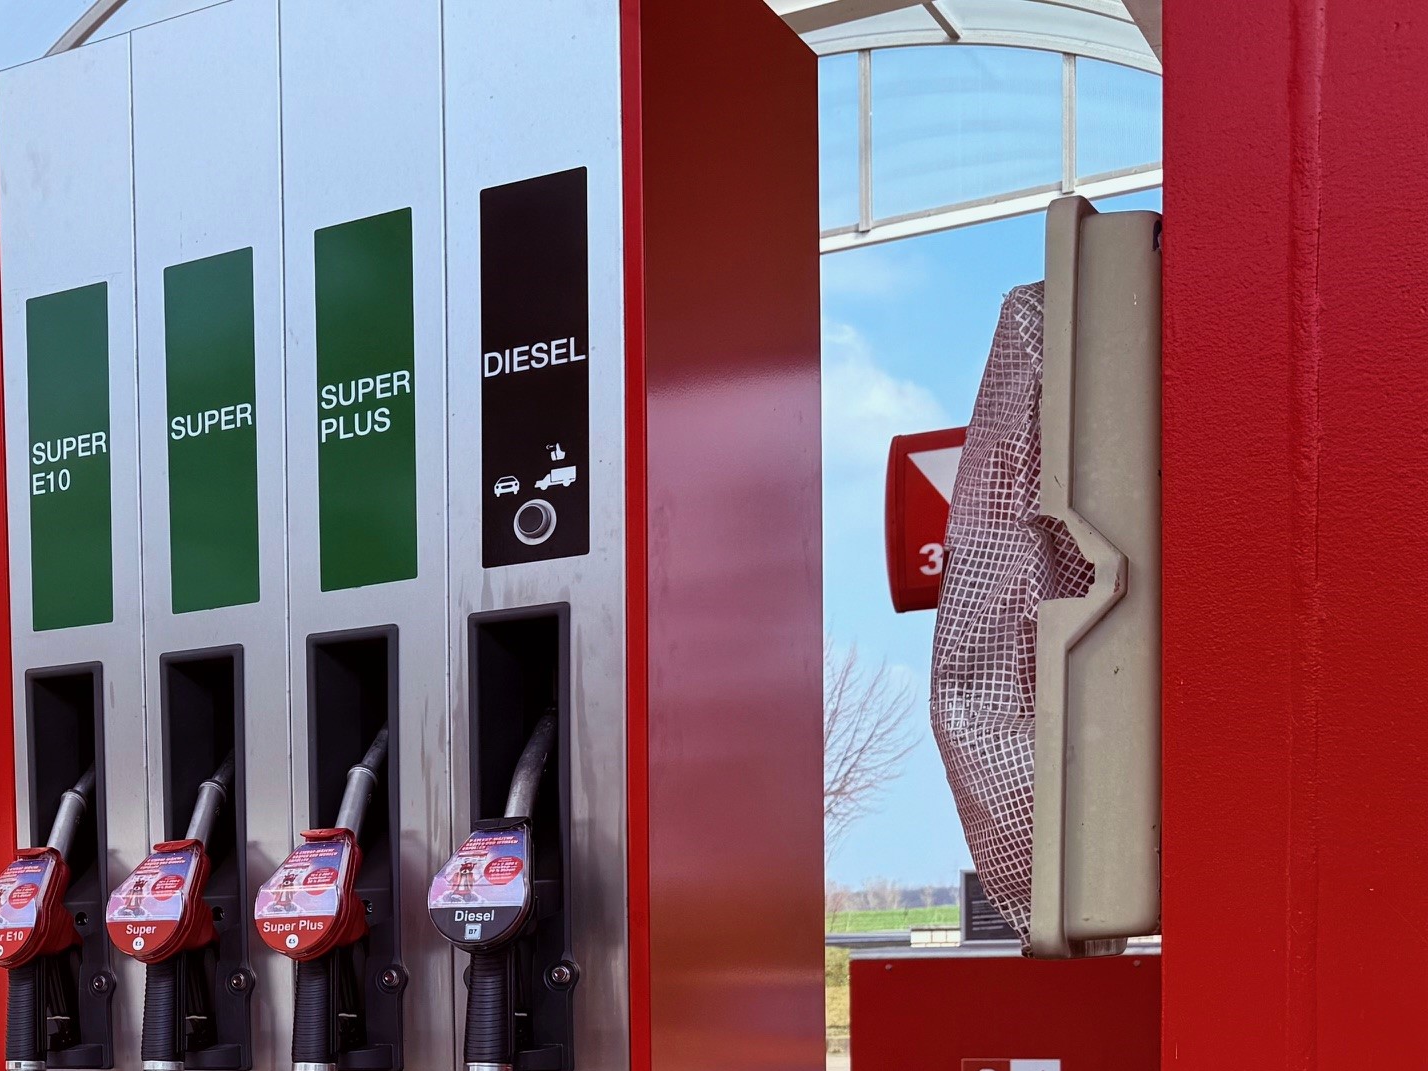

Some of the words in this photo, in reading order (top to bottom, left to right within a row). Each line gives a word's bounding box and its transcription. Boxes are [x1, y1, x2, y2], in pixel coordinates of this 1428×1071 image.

[483, 336, 586, 378] DIESEL
[321, 369, 411, 410] SUPER
[170, 402, 253, 440] SUPER
[321, 407, 391, 443] PLUS
[32, 431, 107, 466] SUPER
[32, 469, 71, 495] E10
[126, 924, 157, 937] Super
[263, 921, 296, 934] Super
[299, 920, 324, 930] Plus
[454, 909, 495, 922] Diesel
[6, 931, 24, 941] E10
